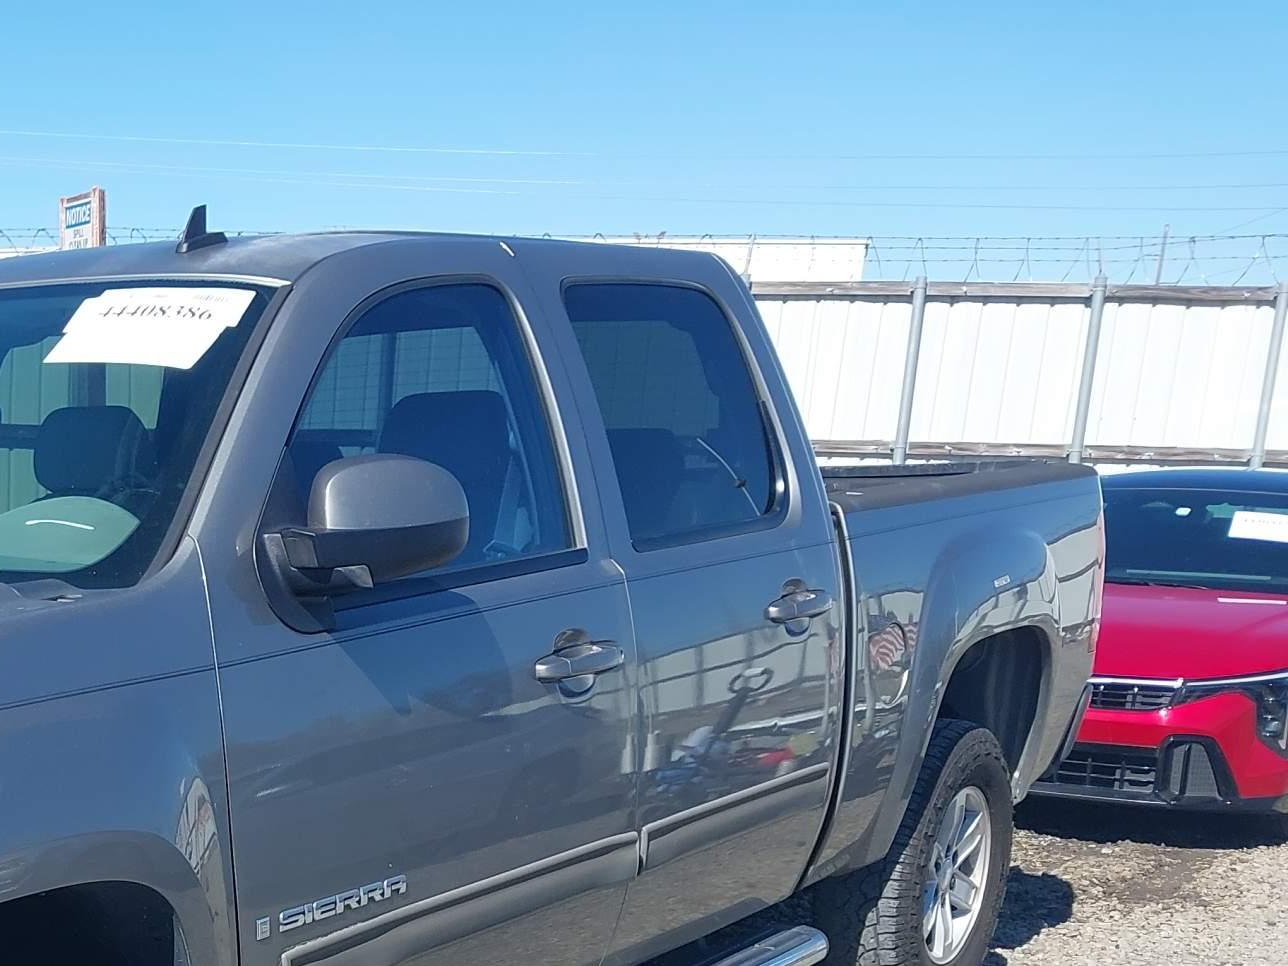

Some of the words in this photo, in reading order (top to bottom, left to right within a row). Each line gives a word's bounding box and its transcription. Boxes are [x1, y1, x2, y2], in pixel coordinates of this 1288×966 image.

[66, 204, 90, 226] NOTICE
[98, 303, 213, 320] 44408386
[279, 874, 407, 933] SIERRA
